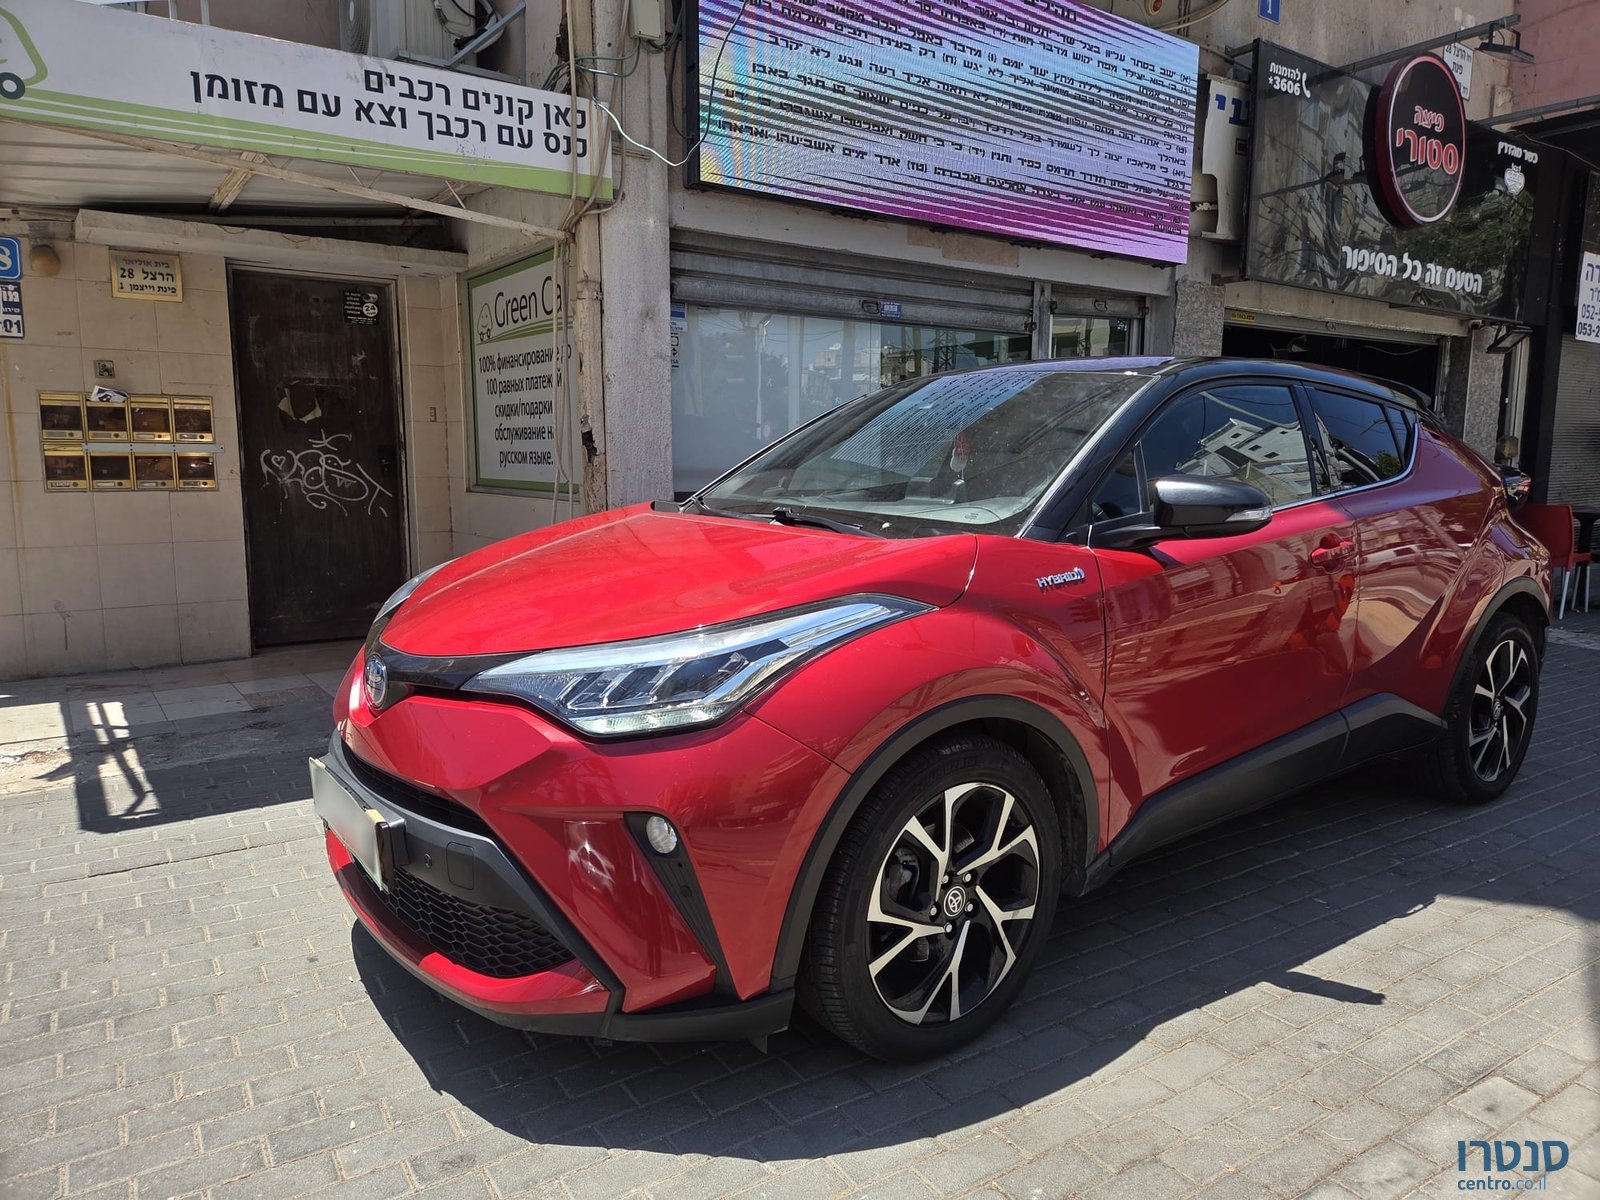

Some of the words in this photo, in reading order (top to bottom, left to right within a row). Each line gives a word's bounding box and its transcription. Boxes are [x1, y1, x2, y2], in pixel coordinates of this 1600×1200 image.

[1269, 62, 1301, 80] להזמנות
[190, 71, 284, 109] מזומן
[364, 69, 451, 106] רכבים
[297, 89, 341, 117] עם
[354, 99, 407, 129] וצא
[462, 88, 533, 125] קונים
[418, 110, 486, 142] רכבך
[1414, 105, 1445, 133] פיצה
[497, 124, 533, 149] עם
[1396, 127, 1459, 175] סטורי
[120, 267, 135, 279] 28
[142, 268, 174, 282] הרצל
[1342, 245, 1398, 278] הסיפור
[1402, 252, 1423, 282] כל
[1425, 263, 1443, 286] זה
[157, 284, 177, 293] פינת
[1445, 267, 1483, 294] הטעם
[494, 291, 538, 328] Green
[1581, 303, 1600, 321] 052-
[479, 354, 496, 374] 100%
[486, 378, 497, 395] 100
[498, 377, 524, 398] равных
[525, 368, 562, 391] платежй
[495, 398, 553, 421] скидки/подарки
[494, 423, 546, 445] обслуживание
[500, 451, 528, 468] русском
[529, 450, 554, 466] языке.
[1036, 570, 1078, 588] HYBRID
